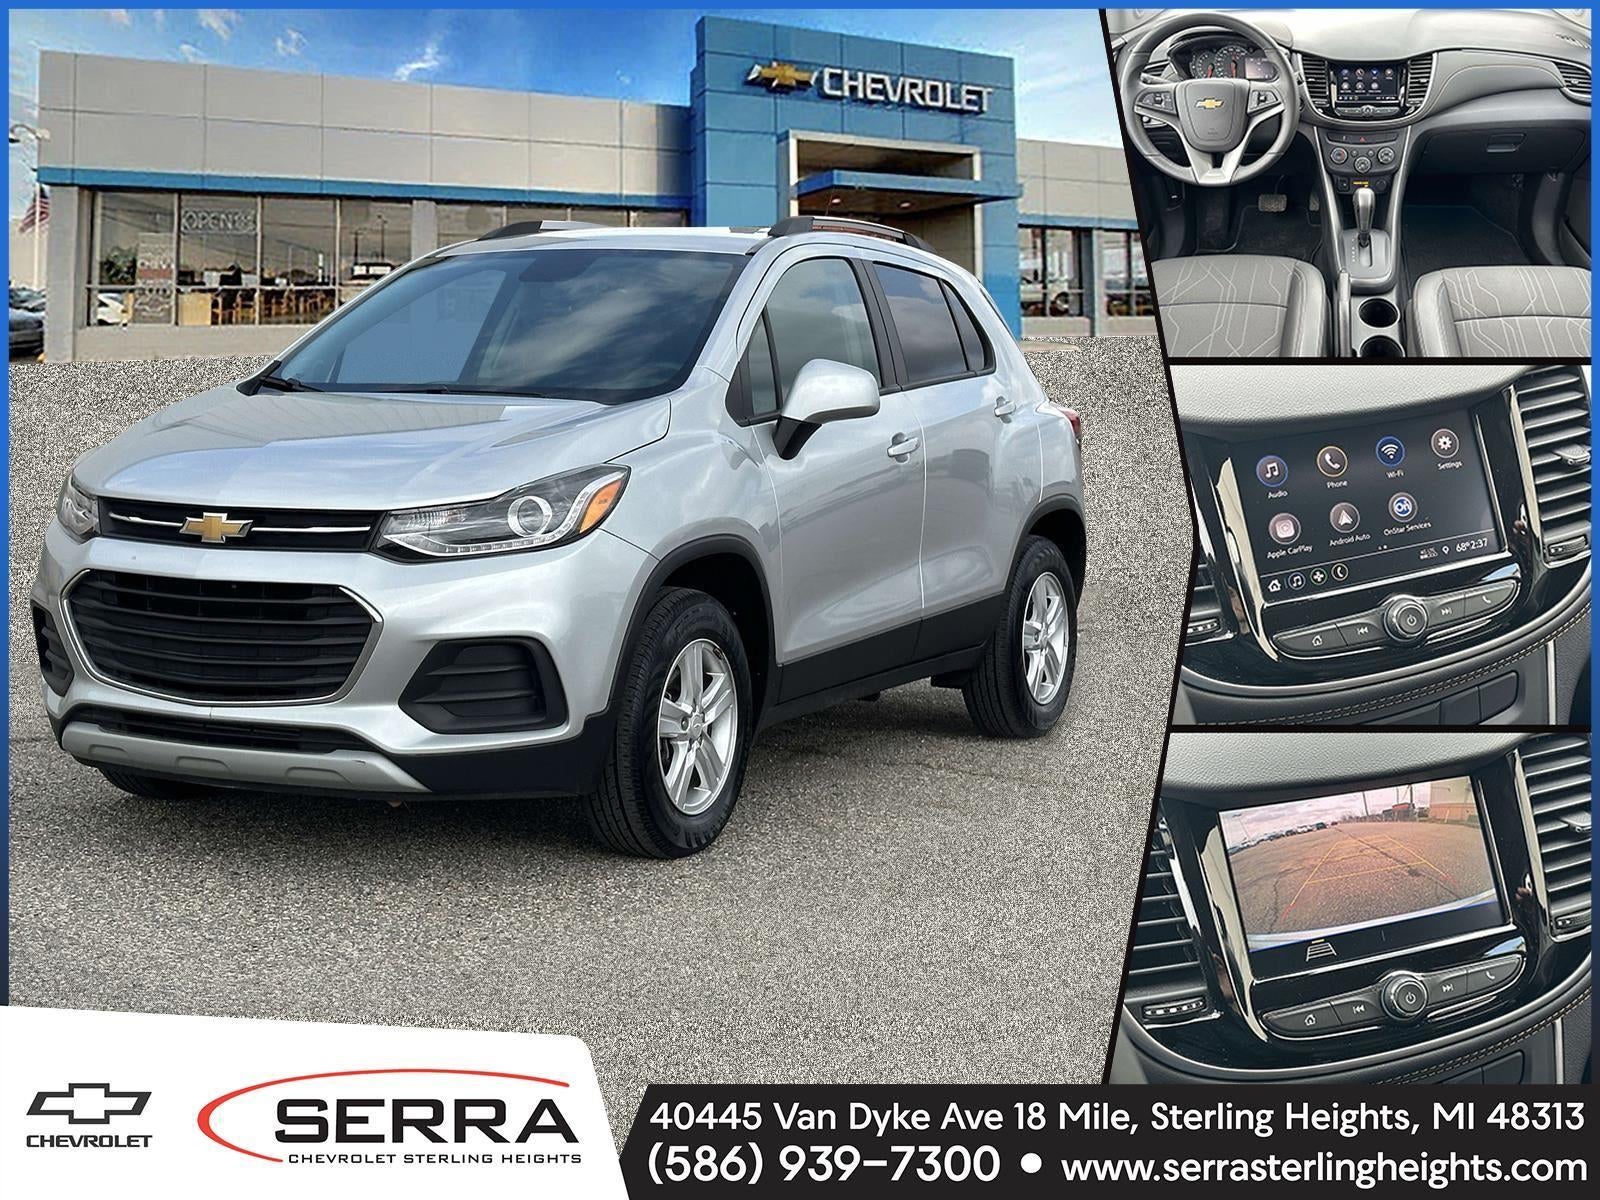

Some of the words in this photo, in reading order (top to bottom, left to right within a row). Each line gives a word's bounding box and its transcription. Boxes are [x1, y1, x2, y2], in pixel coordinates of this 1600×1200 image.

[823, 66, 993, 112] CHEVROLET
[1437, 460, 1463, 470] Settings
[1386, 469, 1404, 478] Wi-Fi
[1326, 480, 1348, 488] Phone
[1267, 490, 1288, 498] Audio
[1383, 526, 1405, 536] OnStar
[1406, 521, 1432, 532] Services
[1329, 537, 1354, 547] Android
[1355, 533, 1371, 541] Auto
[1266, 549, 1286, 559] Apple
[1287, 544, 1313, 555] CarPlay
